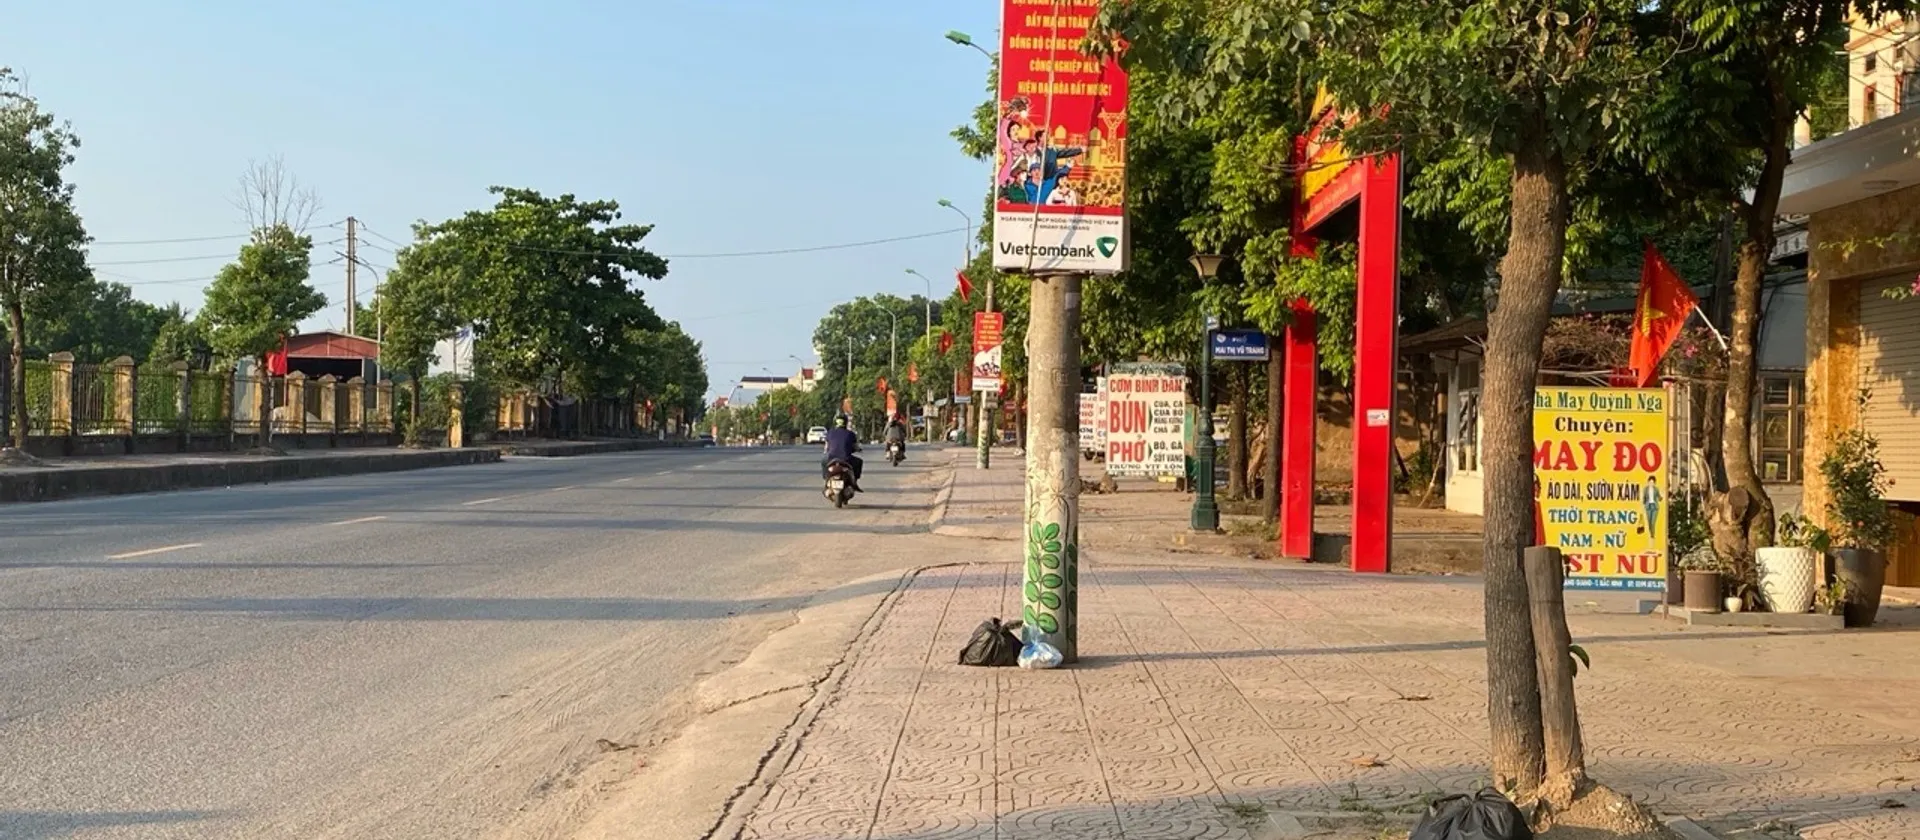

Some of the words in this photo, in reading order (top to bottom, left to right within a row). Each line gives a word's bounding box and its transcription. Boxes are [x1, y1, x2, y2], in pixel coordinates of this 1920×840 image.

[1000, 242, 1095, 258] Vietcombank
[1109, 394, 1147, 433] BÚN
[1534, 391, 1553, 408] hà
[1557, 391, 1585, 412] May
[1590, 391, 1632, 413] Quỳnh
[1636, 393, 1663, 413] Nga
[1555, 416, 1634, 435] Chuyên:
[1109, 434, 1146, 463] PHỞ
[1533, 439, 1604, 472] MAY
[1613, 441, 1663, 473] ĐO
[1547, 478, 1561, 500] ÁO
[1563, 479, 1584, 502] DÀI,
[1616, 480, 1640, 502] XÁM
[1548, 505, 1583, 524] THỜI
[1586, 510, 1638, 525] TRANG
[1560, 532, 1593, 548] NAM
[1604, 530, 1627, 549] NỮ
[1616, 550, 1663, 575] NỮ
